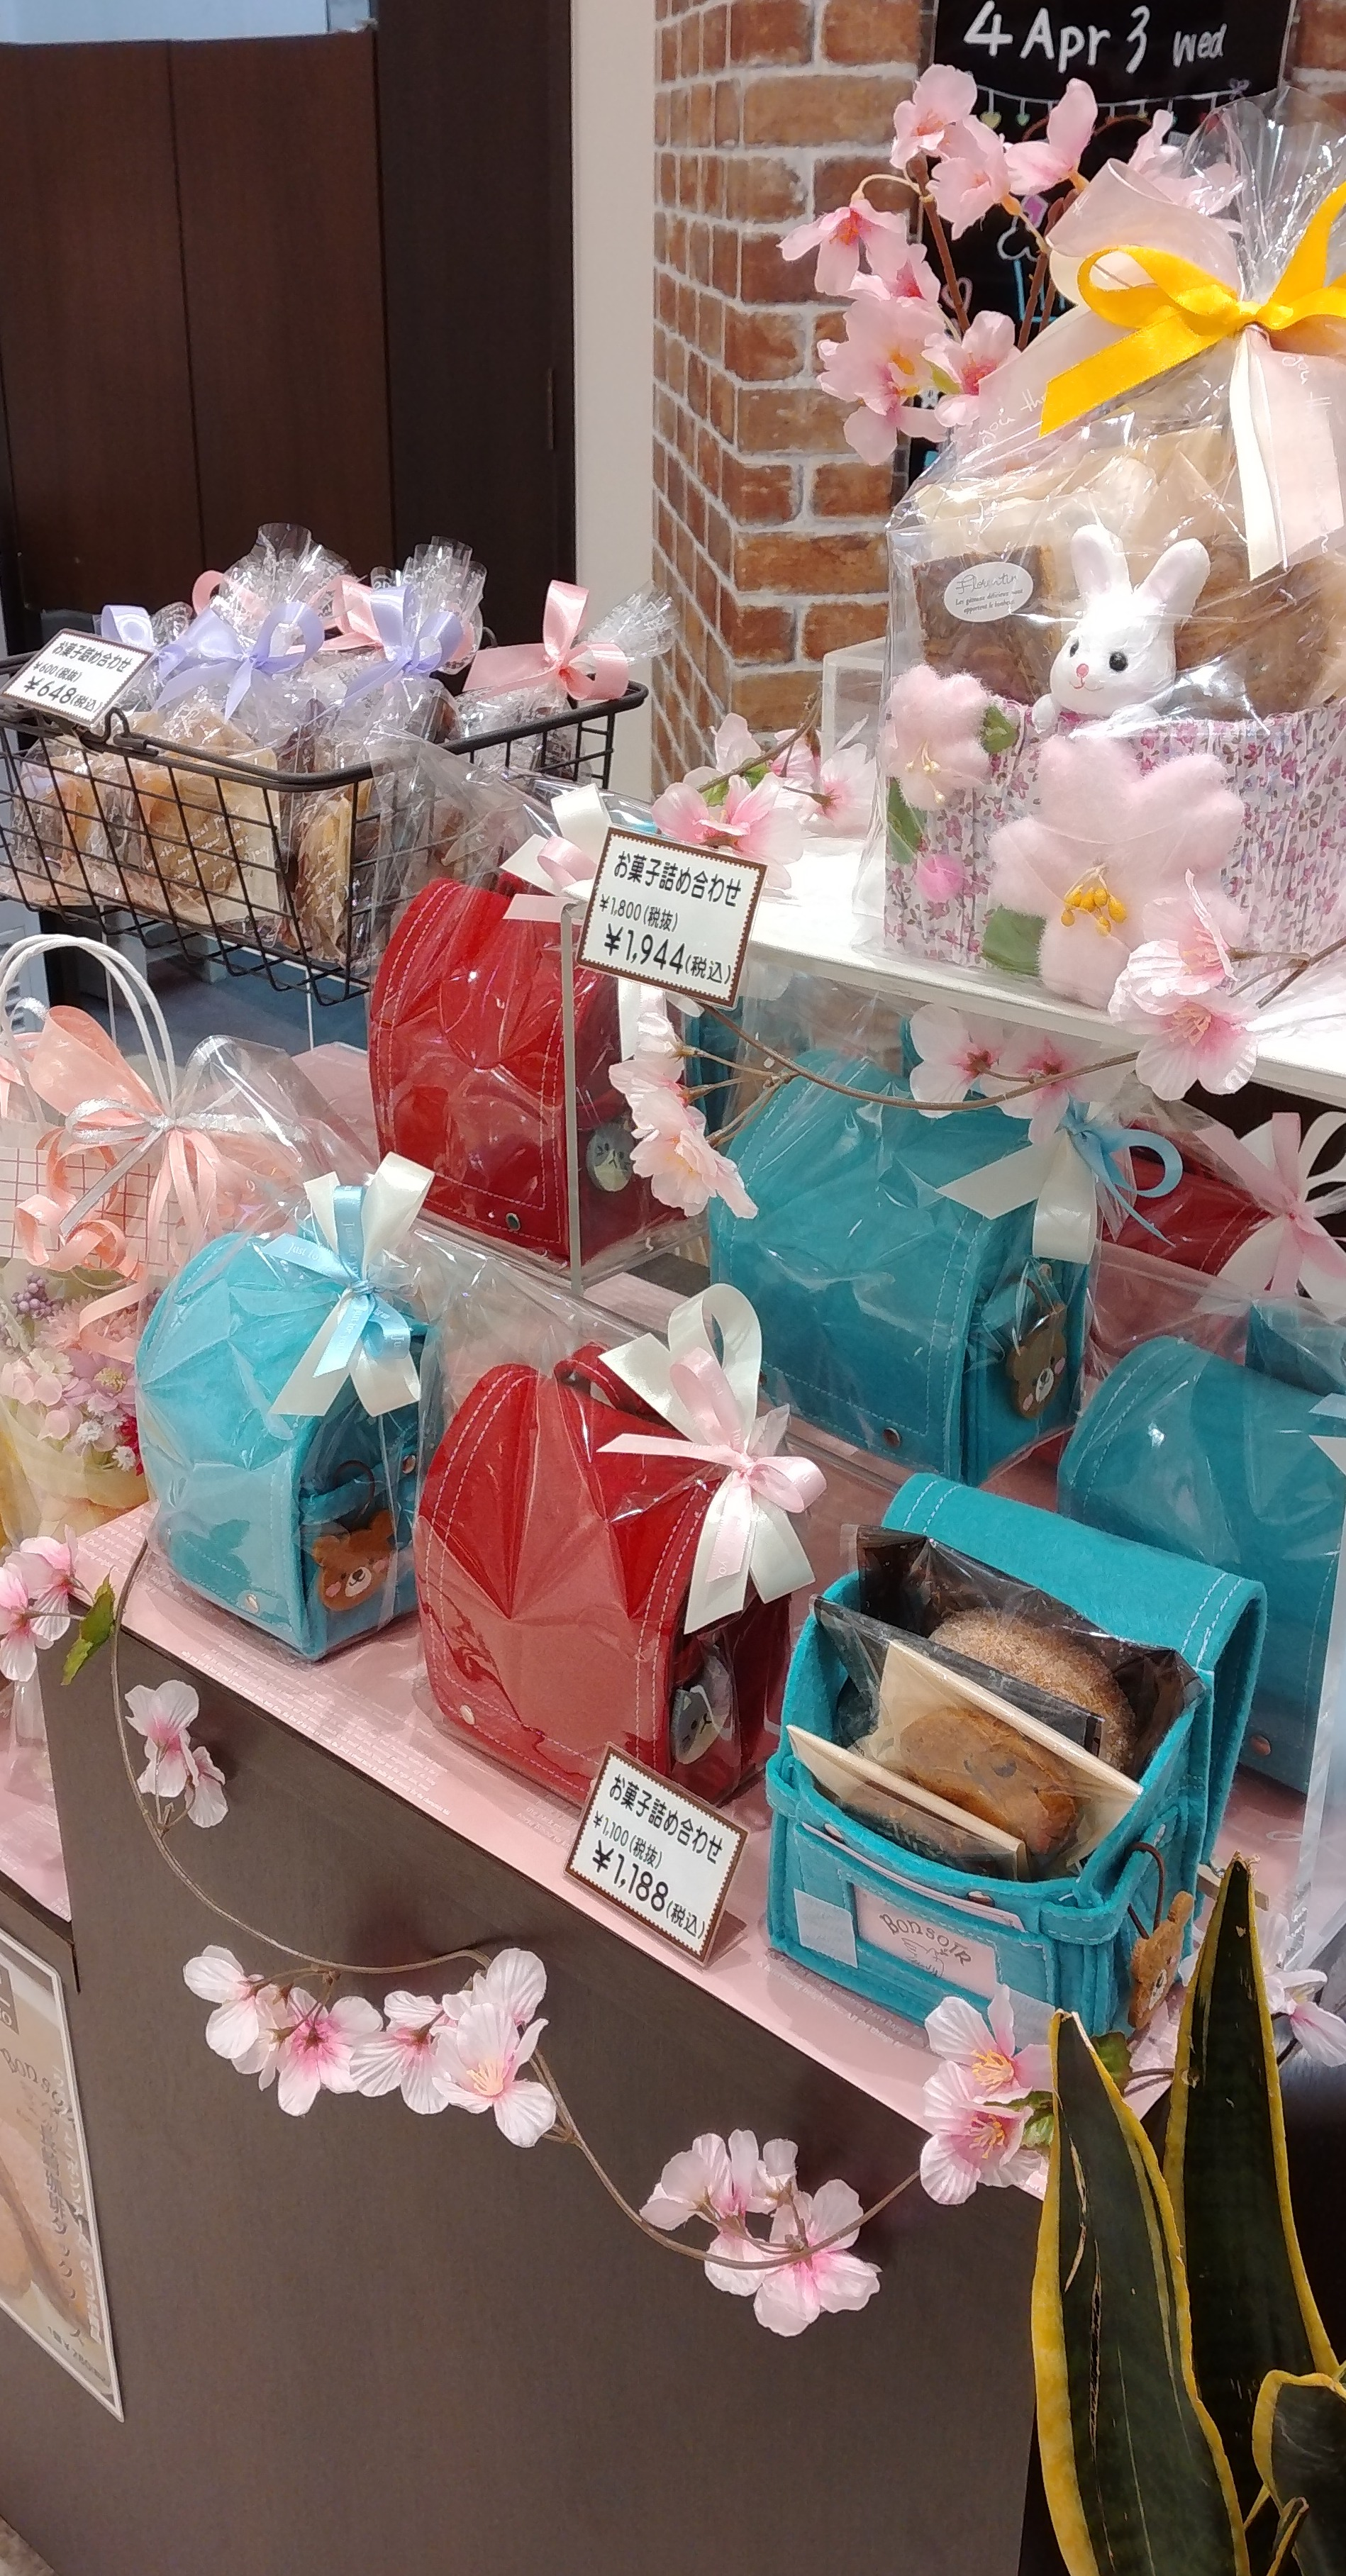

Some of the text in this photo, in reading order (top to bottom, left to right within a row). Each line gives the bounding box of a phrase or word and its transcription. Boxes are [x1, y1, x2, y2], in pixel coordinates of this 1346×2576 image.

[963, 0, 1013, 57] 4
[1020, 7, 1111, 73] Apr
[1125, 5, 1150, 74] 3
[52, 640, 133, 673] お菓子詰め合わせ
[613, 851, 742, 907] お菓子詰め合わせ
[609, 1773, 723, 1864] お菓子詰め合わせ
